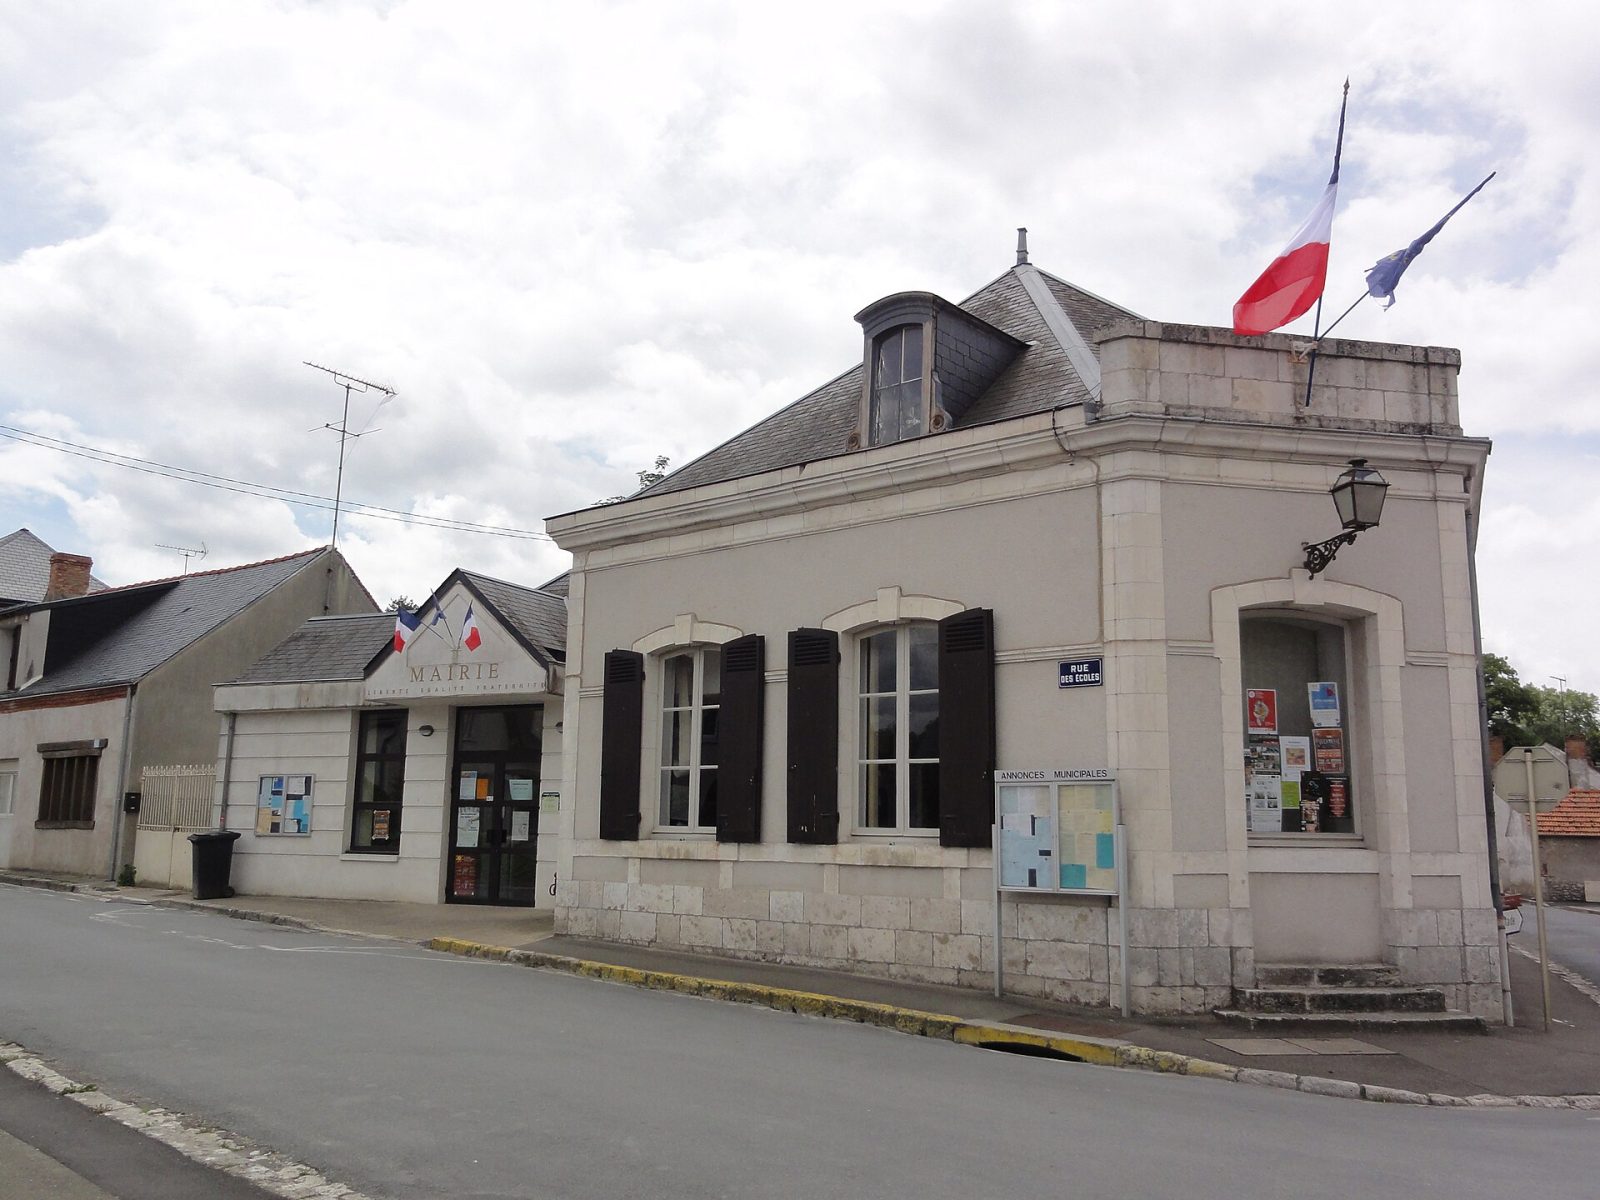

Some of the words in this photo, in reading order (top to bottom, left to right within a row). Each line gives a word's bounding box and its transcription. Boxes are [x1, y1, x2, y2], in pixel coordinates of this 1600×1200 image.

[410, 663, 499, 682] MAIRIE
[1071, 664, 1089, 673] RUE
[1061, 675, 1074, 683] DES
[1001, 771, 1045, 779] ANNONCES
[1054, 769, 1108, 778] MUNICIPALES
